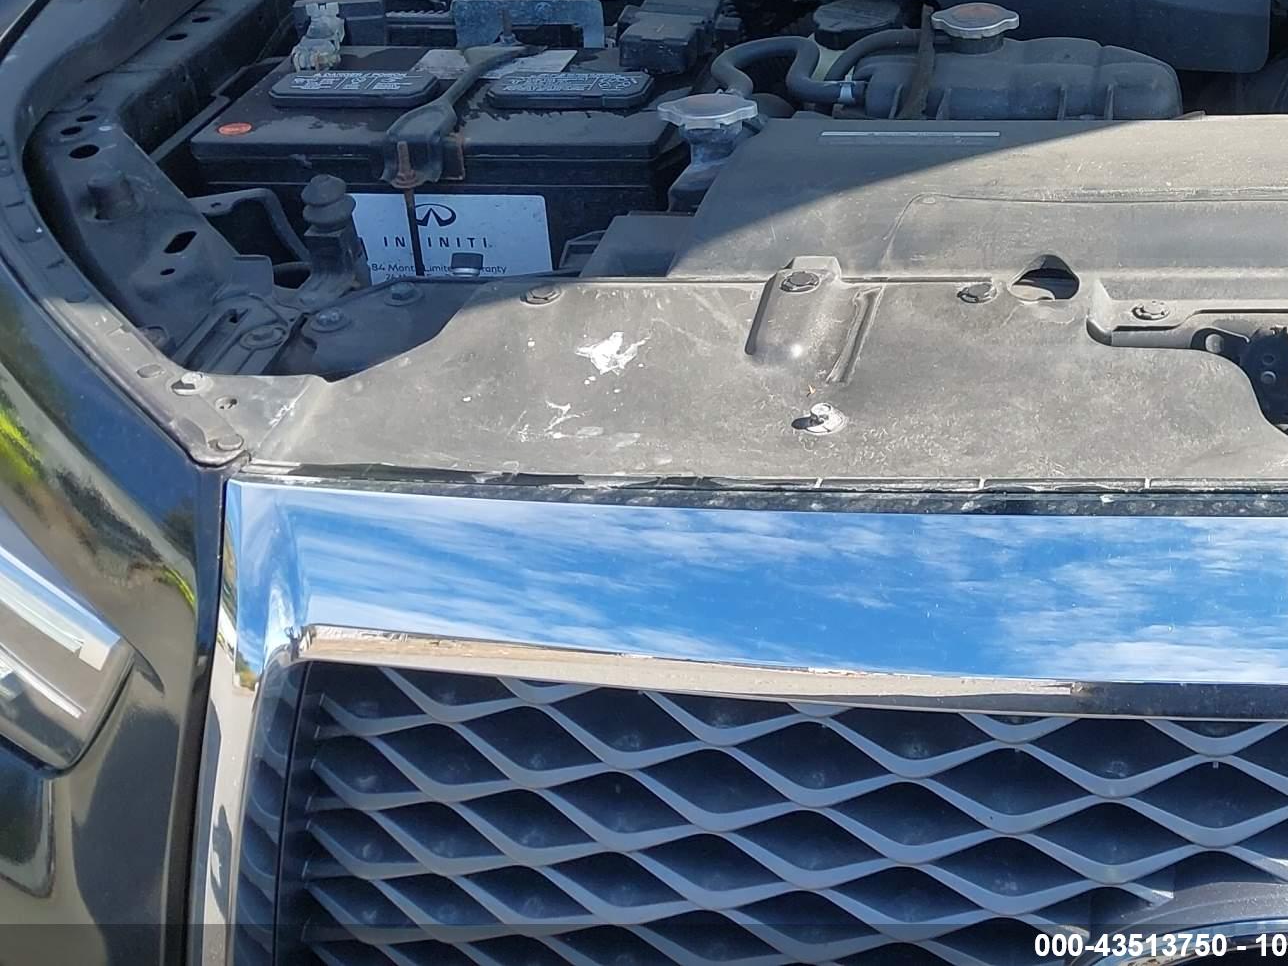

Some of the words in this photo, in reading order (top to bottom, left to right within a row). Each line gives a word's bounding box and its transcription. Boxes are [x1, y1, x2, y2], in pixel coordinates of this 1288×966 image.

[383, 236, 488, 248] ININITI
[371, 263, 385, 272] 84
[387, 263, 415, 272] Mont
